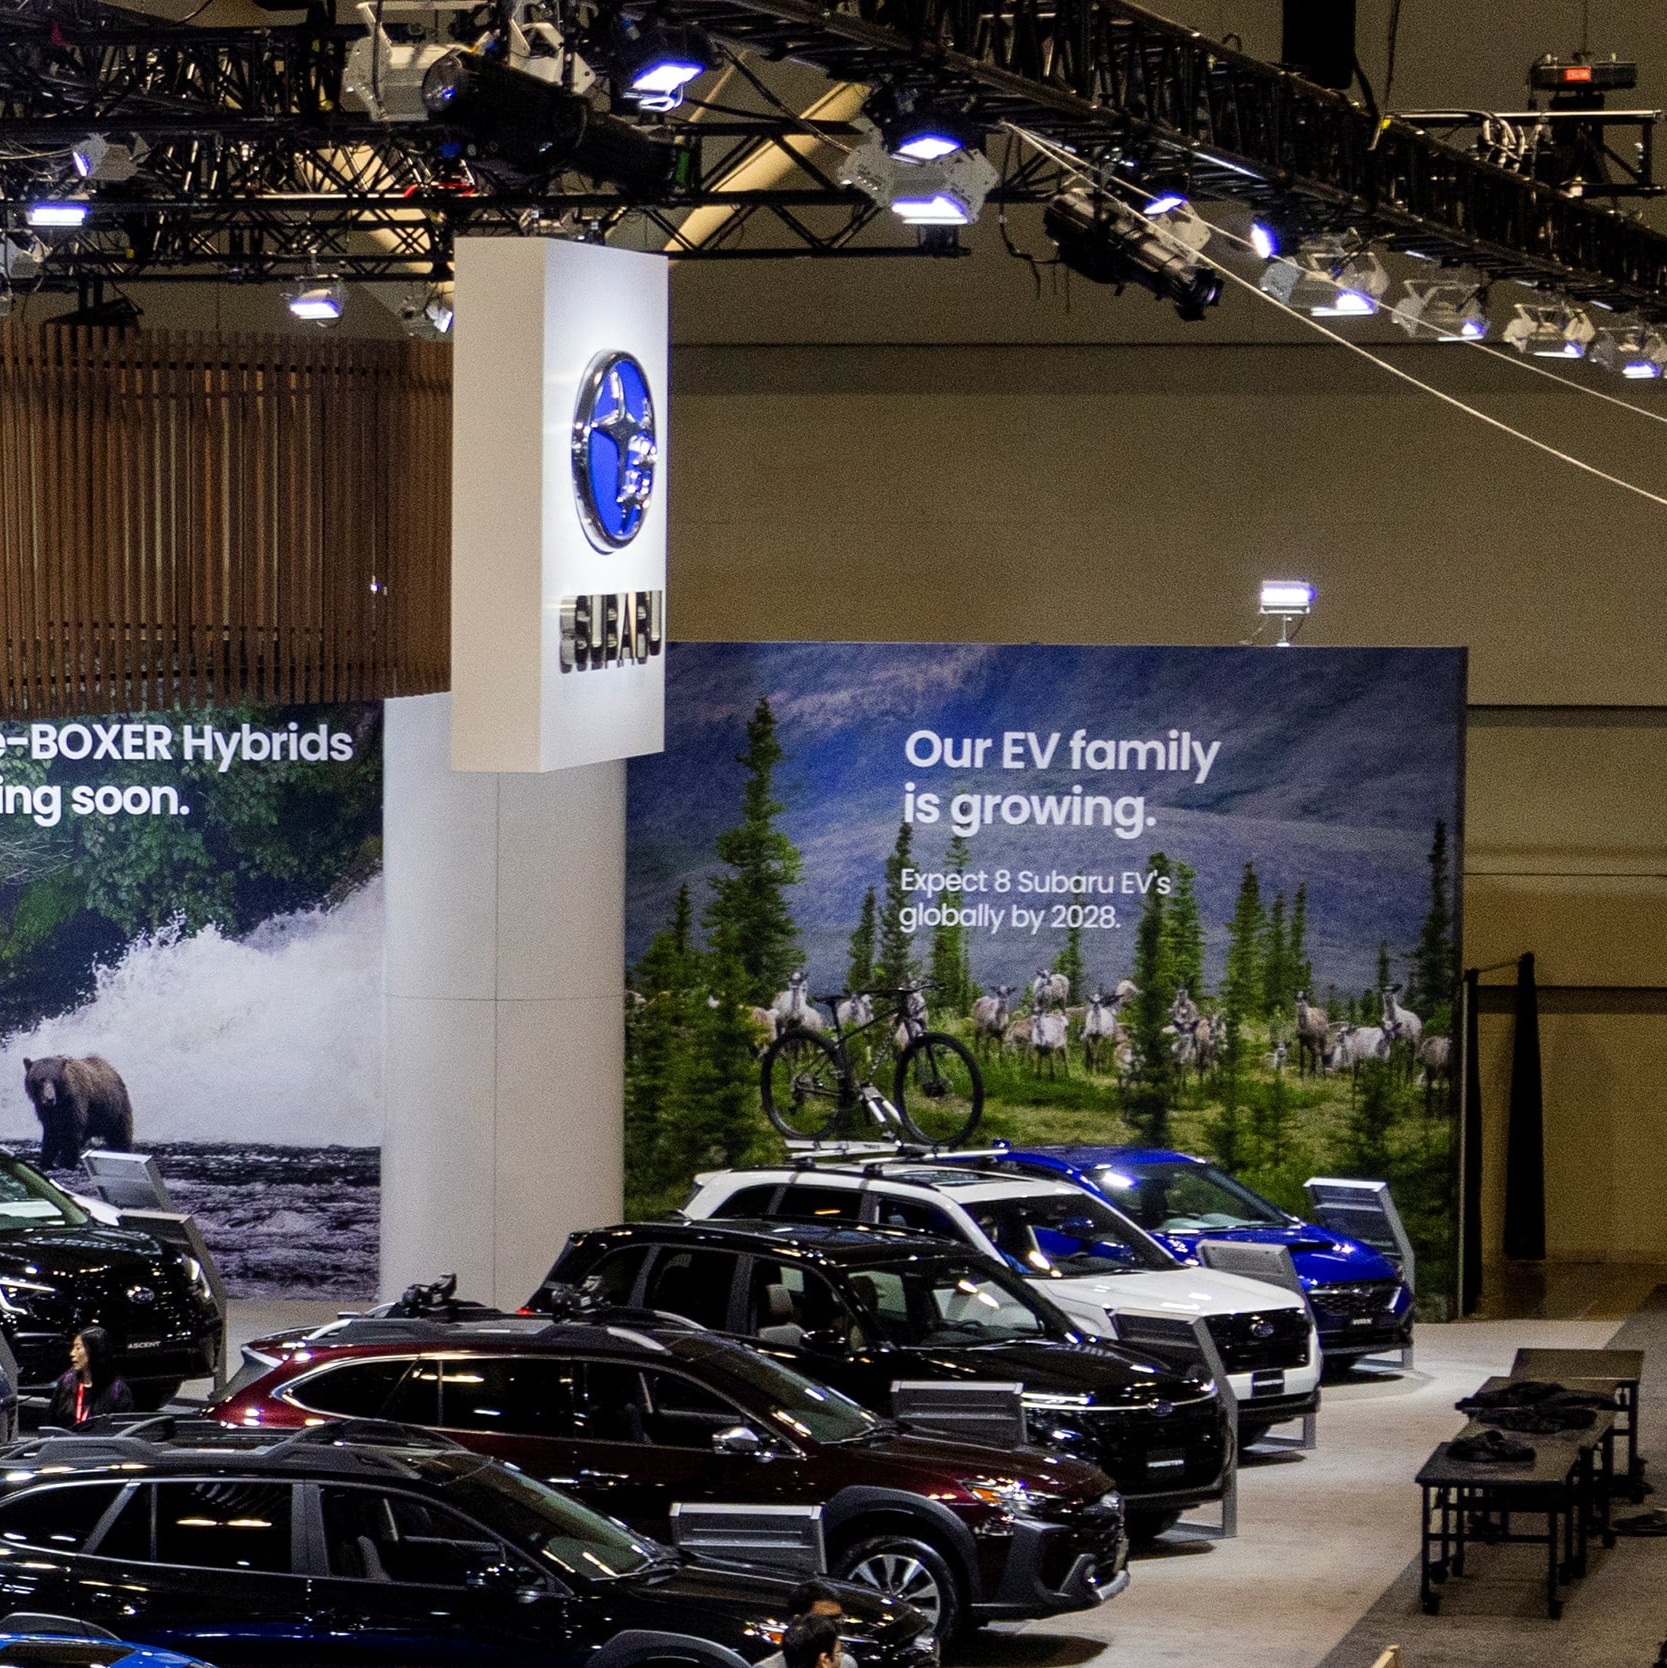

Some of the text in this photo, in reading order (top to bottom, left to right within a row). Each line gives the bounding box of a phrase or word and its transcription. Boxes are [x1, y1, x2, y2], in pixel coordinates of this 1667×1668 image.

[560, 591, 662, 673] SUBARU
[182, 722, 354, 772] Hybrids
[905, 729, 1221, 784] Our EV family
[71, 785, 190, 815] soon.
[904, 782, 1157, 839] is growing.
[900, 868, 1172, 897] Expect 8 Subaru EV's
[899, 903, 1121, 935] globally by 2028.
[127, 1341, 161, 1349] ASCENT
